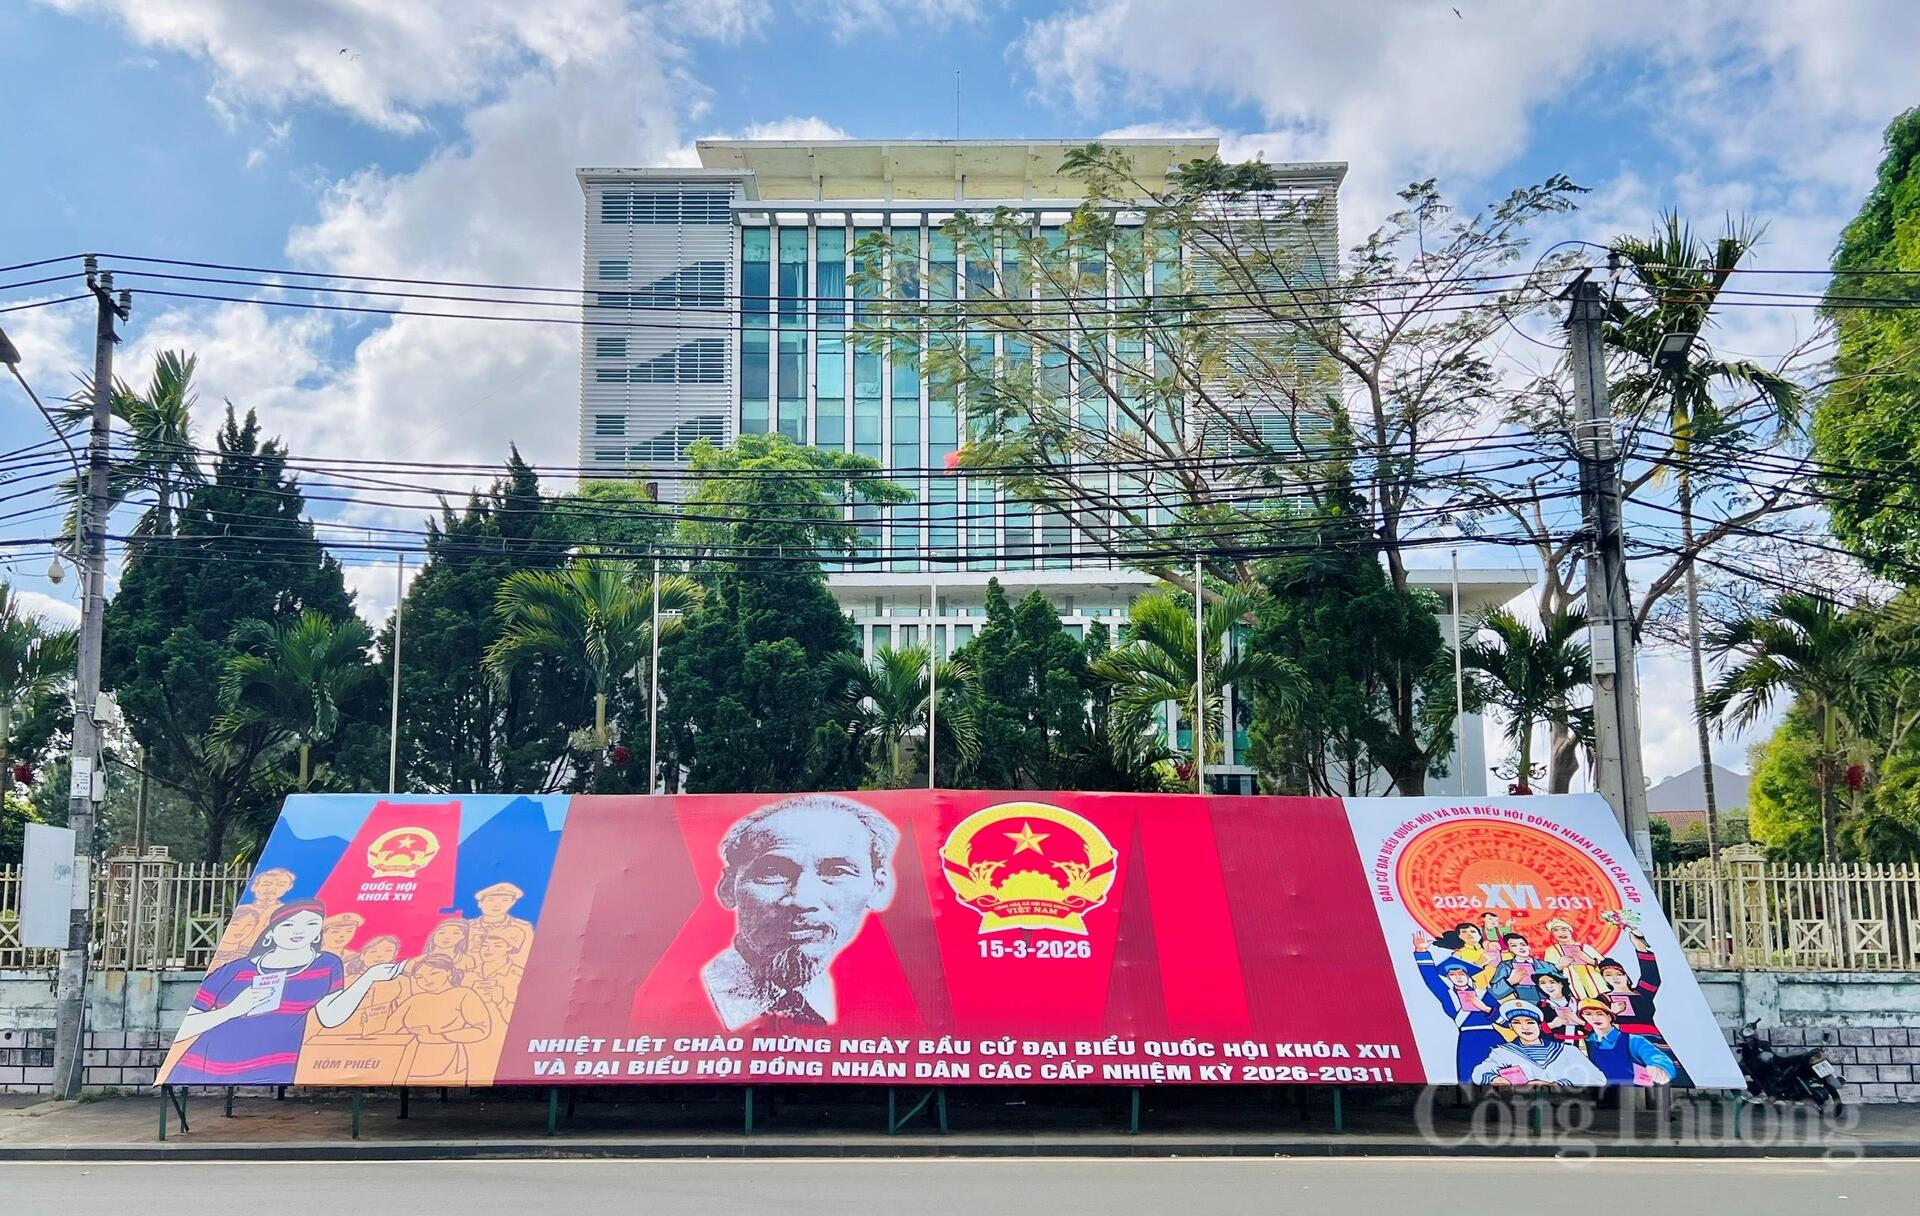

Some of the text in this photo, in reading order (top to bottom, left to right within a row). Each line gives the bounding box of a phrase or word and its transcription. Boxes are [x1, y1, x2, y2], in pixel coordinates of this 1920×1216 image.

[361, 880, 418, 893] QUỐC HỘI
[392, 893, 414, 902] XVI
[1433, 883, 1594, 910] 2026 XVI 2031
[1033, 907, 1058, 915] NAM
[978, 939, 1092, 959] 15-3-2026
[528, 1035, 1401, 1060] NHIỆT LIỆT CHÀO MỪNG NGÀY BẦU CỬ ĐẠI BIỂU QUỐC HỘI KHÓA XVI
[344, 1056, 380, 1070] PHIẾU
[534, 1055, 1394, 1083] VÀ ĐẠI BIỂU HỘI ĐỒNG NHÂN DÂN CÁC CẤP NHIỆM KỲ 2026-2031!
